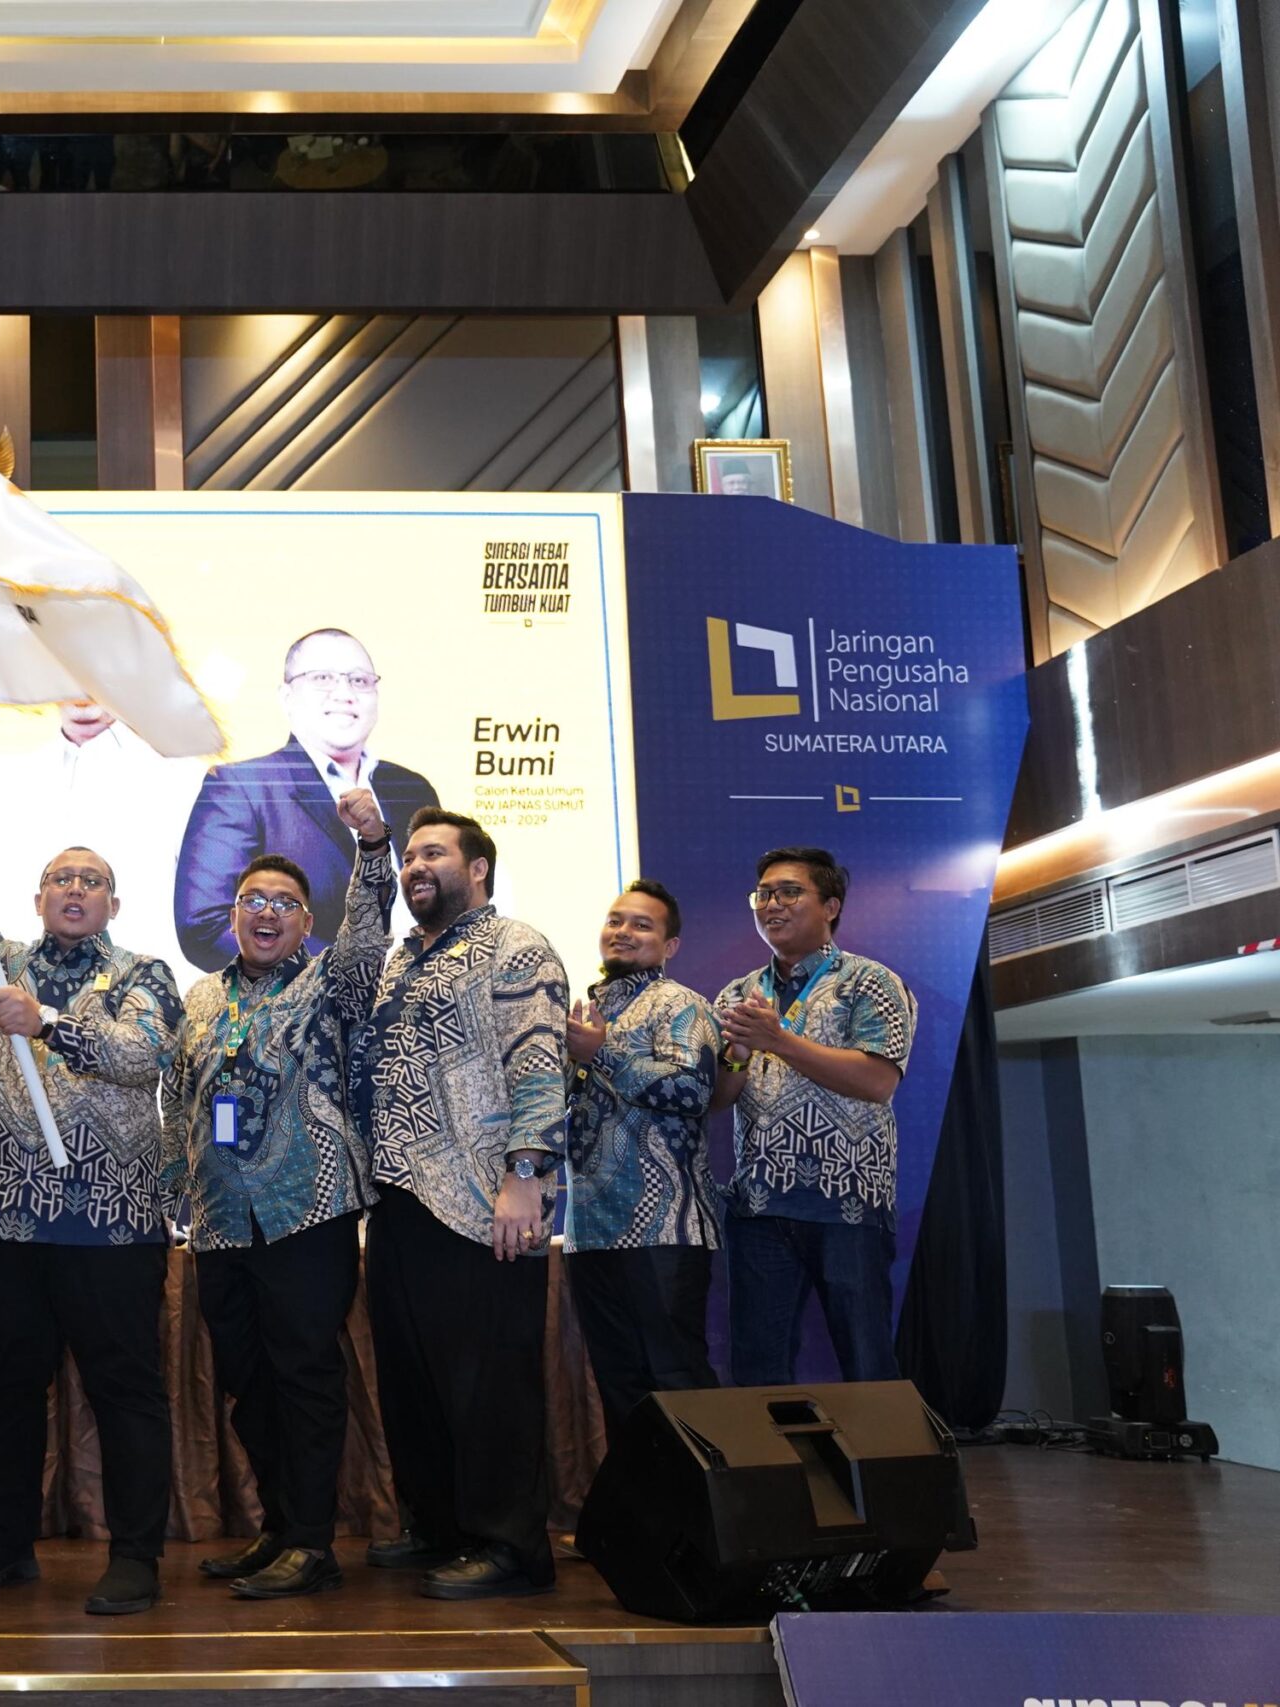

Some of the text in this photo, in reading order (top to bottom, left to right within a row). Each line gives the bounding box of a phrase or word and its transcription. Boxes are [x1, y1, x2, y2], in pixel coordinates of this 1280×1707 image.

[484, 542, 569, 560] SINERGI HEBAT
[482, 562, 569, 590] BERSAMA
[484, 594, 571, 613] TUMBUH KUAT
[825, 629, 935, 660] Jaringan
[827, 657, 969, 690] Pengusaha
[829, 687, 940, 713] Nasional
[474, 717, 560, 743] Erwin
[764, 734, 948, 754] SUMATERA UTARA
[475, 751, 555, 776] Bumi
[511, 786, 544, 796] Ketua
[544, 800, 585, 810] SUMUT
